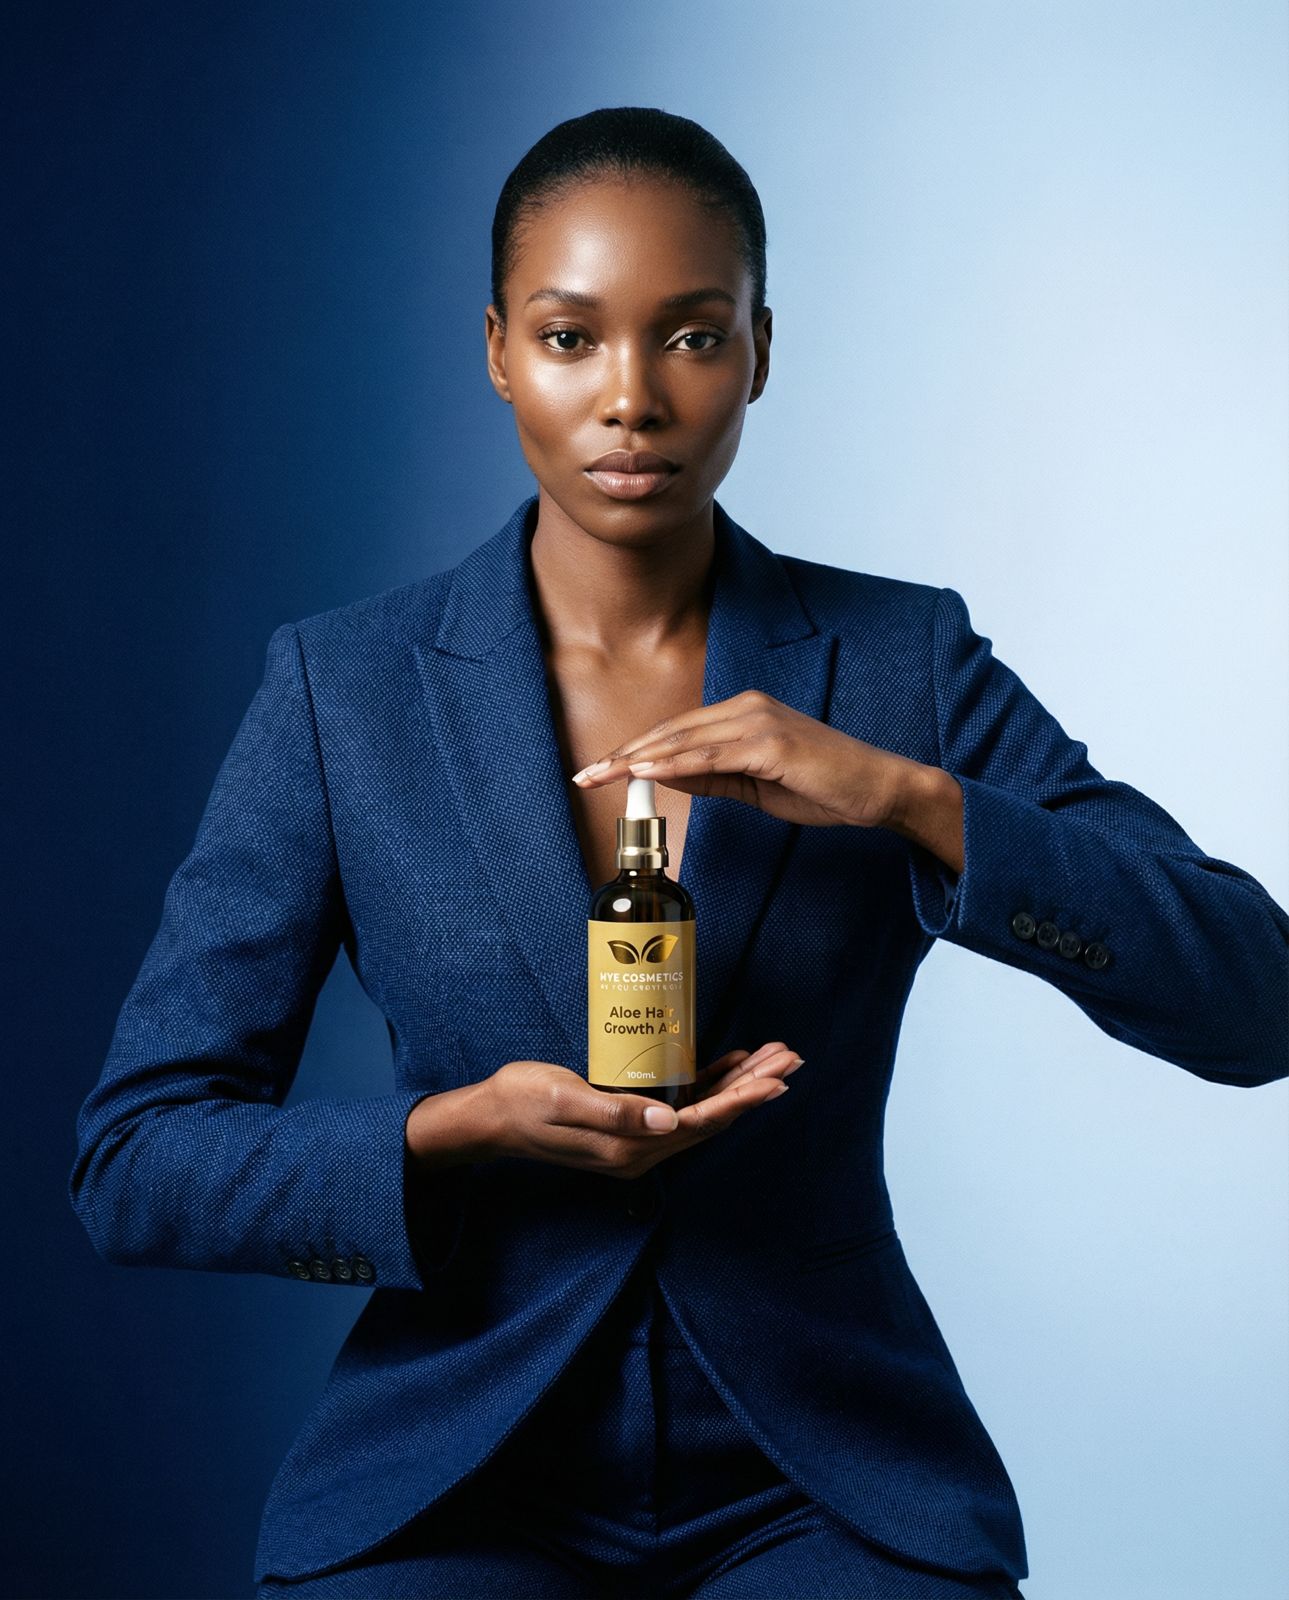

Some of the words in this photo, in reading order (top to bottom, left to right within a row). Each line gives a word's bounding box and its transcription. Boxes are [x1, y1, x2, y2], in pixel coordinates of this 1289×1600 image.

[622, 972, 684, 983] COSMETICS
[609, 1006, 641, 1018] Aloe
[645, 1005, 674, 1018] Hair
[604, 1022, 654, 1034] Growth
[658, 1020, 680, 1034] Aid
[626, 1071, 656, 1079] 100mL
